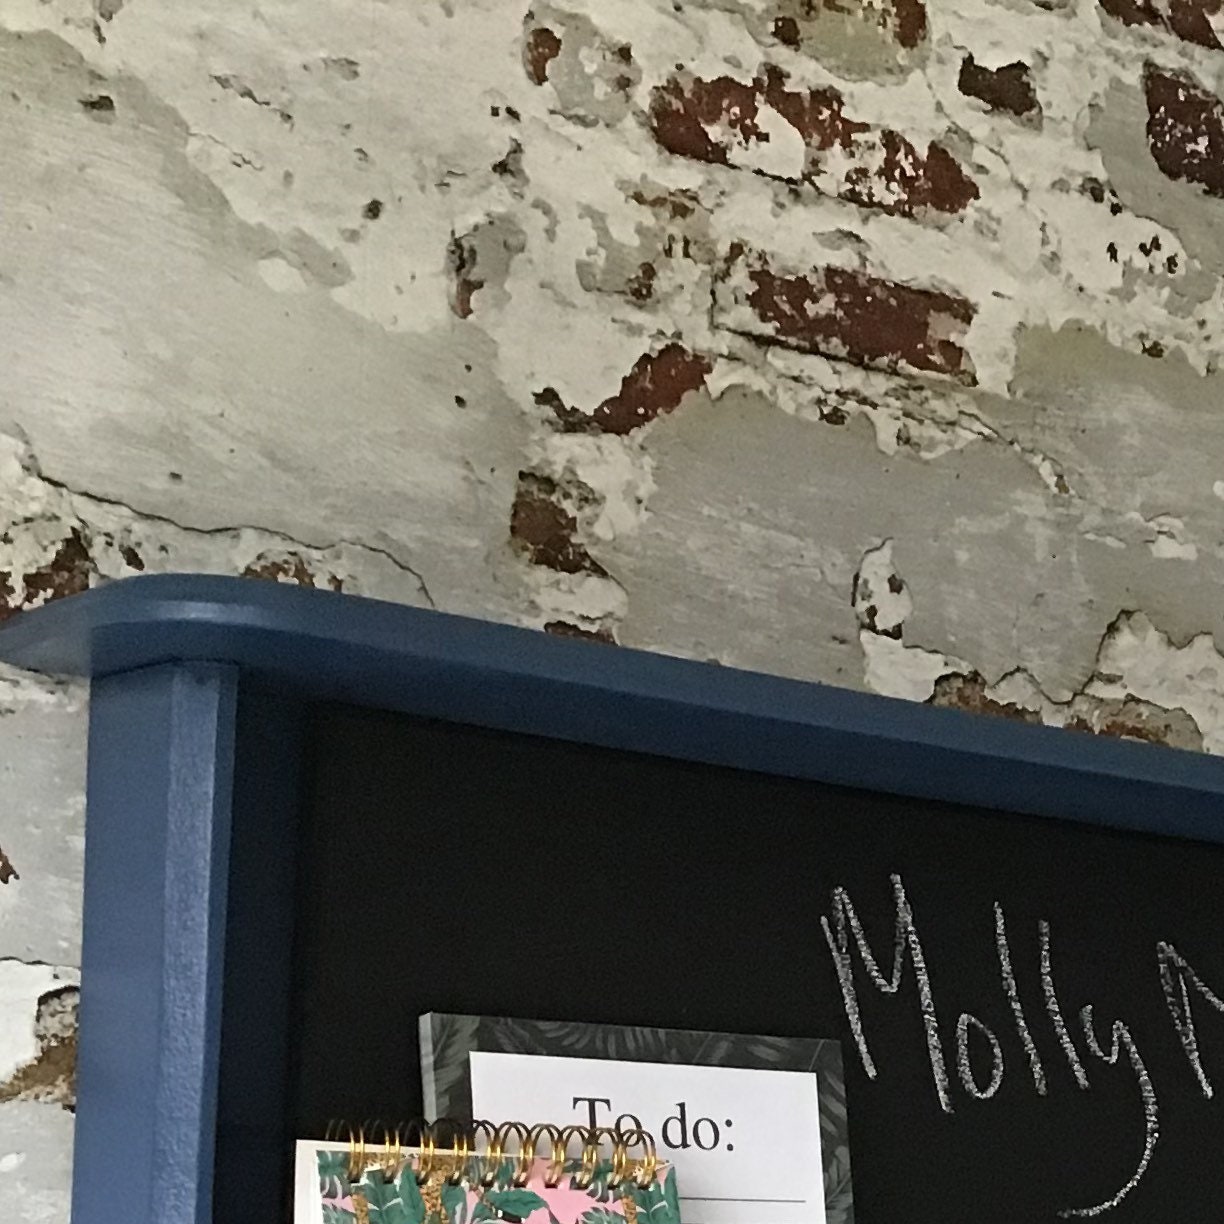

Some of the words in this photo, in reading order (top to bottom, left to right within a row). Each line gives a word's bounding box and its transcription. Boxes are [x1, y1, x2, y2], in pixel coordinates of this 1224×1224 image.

[573, 1096, 643, 1148] To
[662, 1102, 735, 1152] do:
[820, 872, 1159, 1218] Molly
